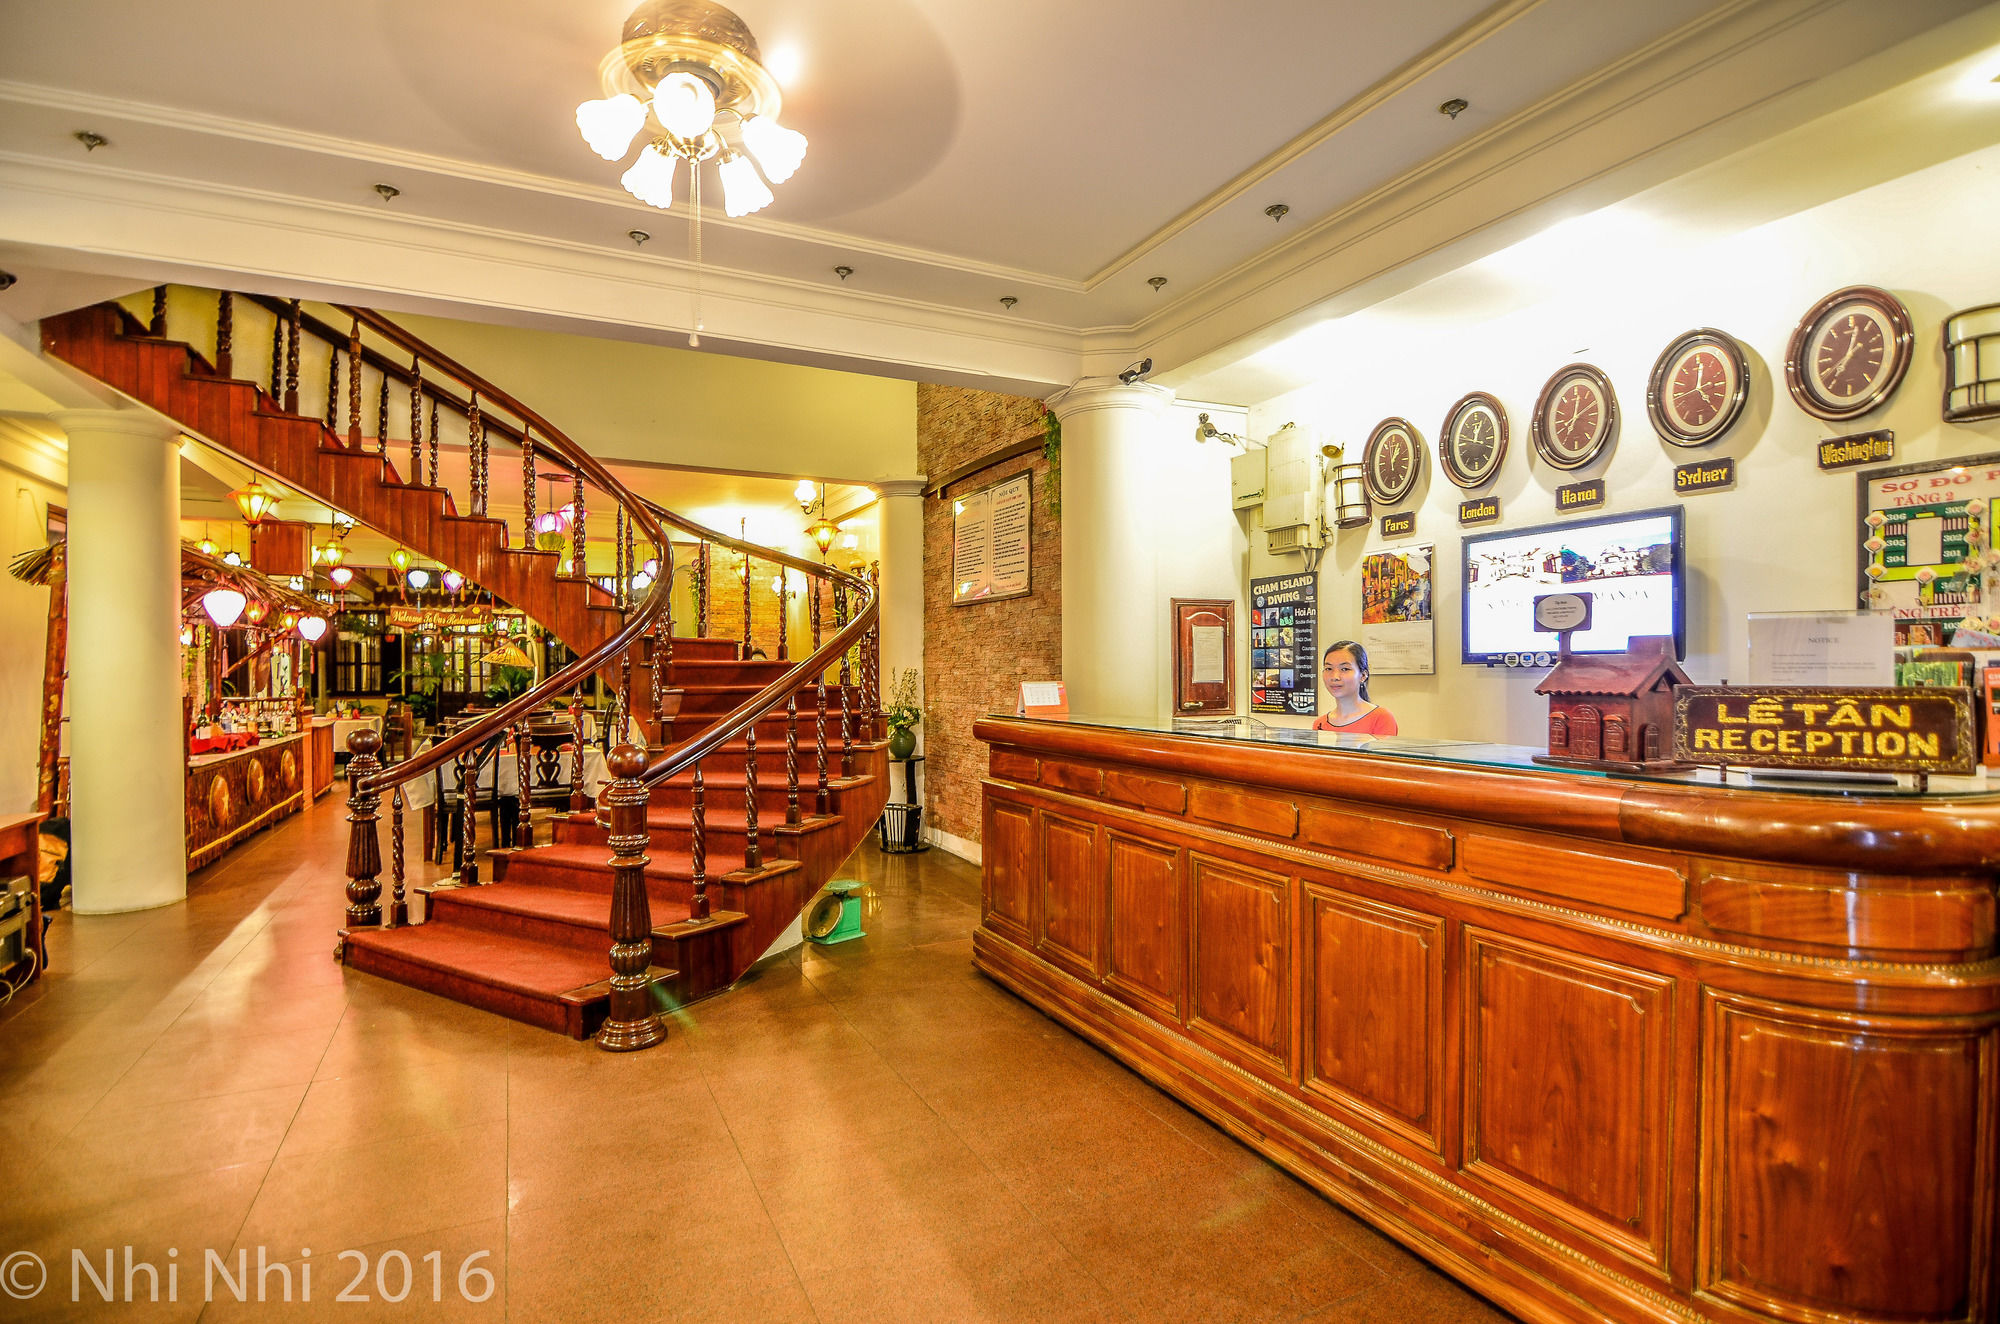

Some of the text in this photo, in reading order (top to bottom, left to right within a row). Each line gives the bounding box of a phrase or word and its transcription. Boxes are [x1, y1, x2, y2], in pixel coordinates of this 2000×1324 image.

[1820, 436, 1889, 465] Washington
[1677, 467, 1728, 487] Sydney
[1561, 488, 1597, 505] Hanoi
[1945, 491, 1955, 501] 2
[1461, 502, 1496, 520] London
[1385, 519, 1409, 532] Paris
[1886, 539, 1906, 547] 305
[1943, 534, 1963, 542] 302
[1886, 555, 1905, 563] 304
[1943, 550, 1961, 558] 301
[1253, 575, 1313, 595] CHAM ISLAND
[1267, 591, 1300, 605] DIVING
[393, 610, 422, 623] Welcome
[424, 612, 432, 623] To
[433, 612, 445, 624] Our
[1294, 607, 1316, 617] Hoi An
[1792, 698, 1913, 728] TÂN
[1694, 728, 1940, 758] RECEPTION
